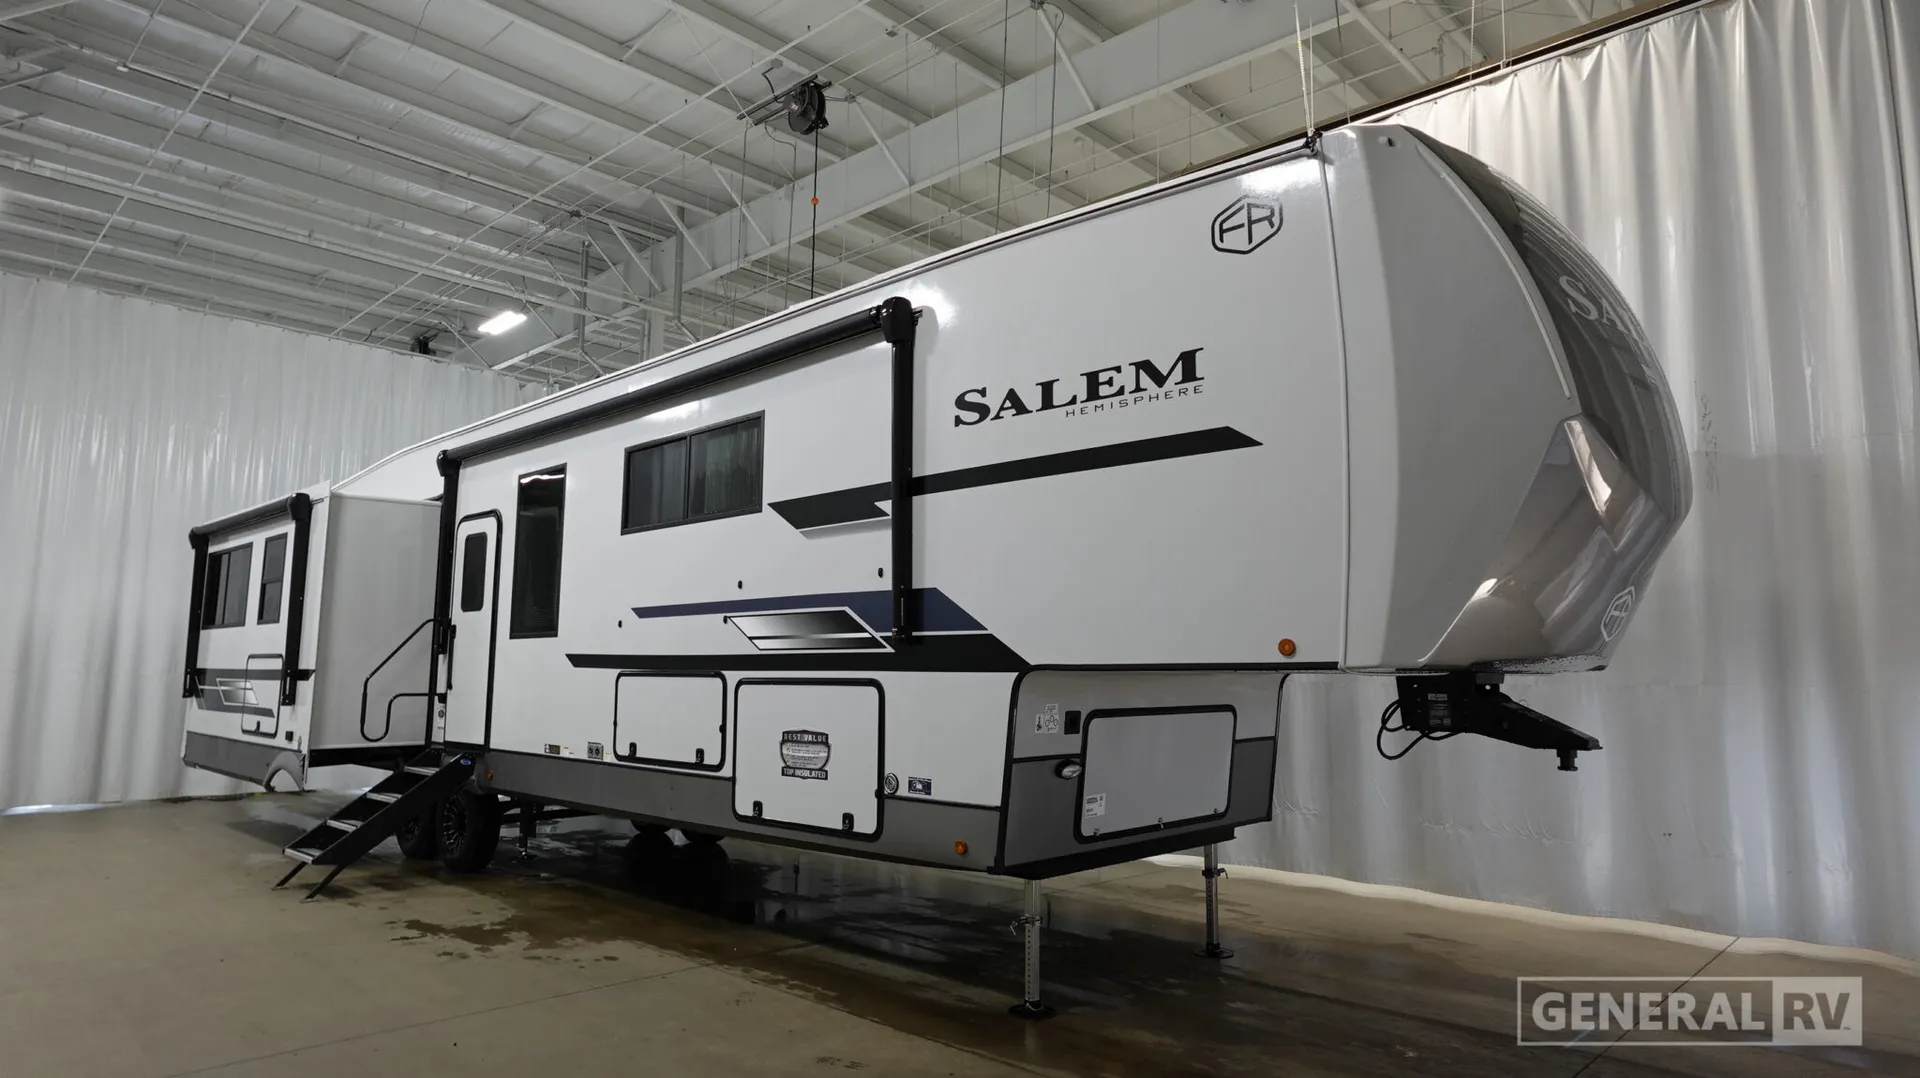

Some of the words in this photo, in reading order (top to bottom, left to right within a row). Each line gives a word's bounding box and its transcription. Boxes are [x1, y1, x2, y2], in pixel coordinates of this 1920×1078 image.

[1217, 202, 1277, 246] FR
[954, 347, 1205, 428] SALEM
[1065, 384, 1204, 419] HEMISPHERE
[783, 733, 801, 742] BEST
[803, 734, 828, 742] VALUE
[783, 768, 795, 776] TOP
[795, 769, 826, 778] INSULATED
